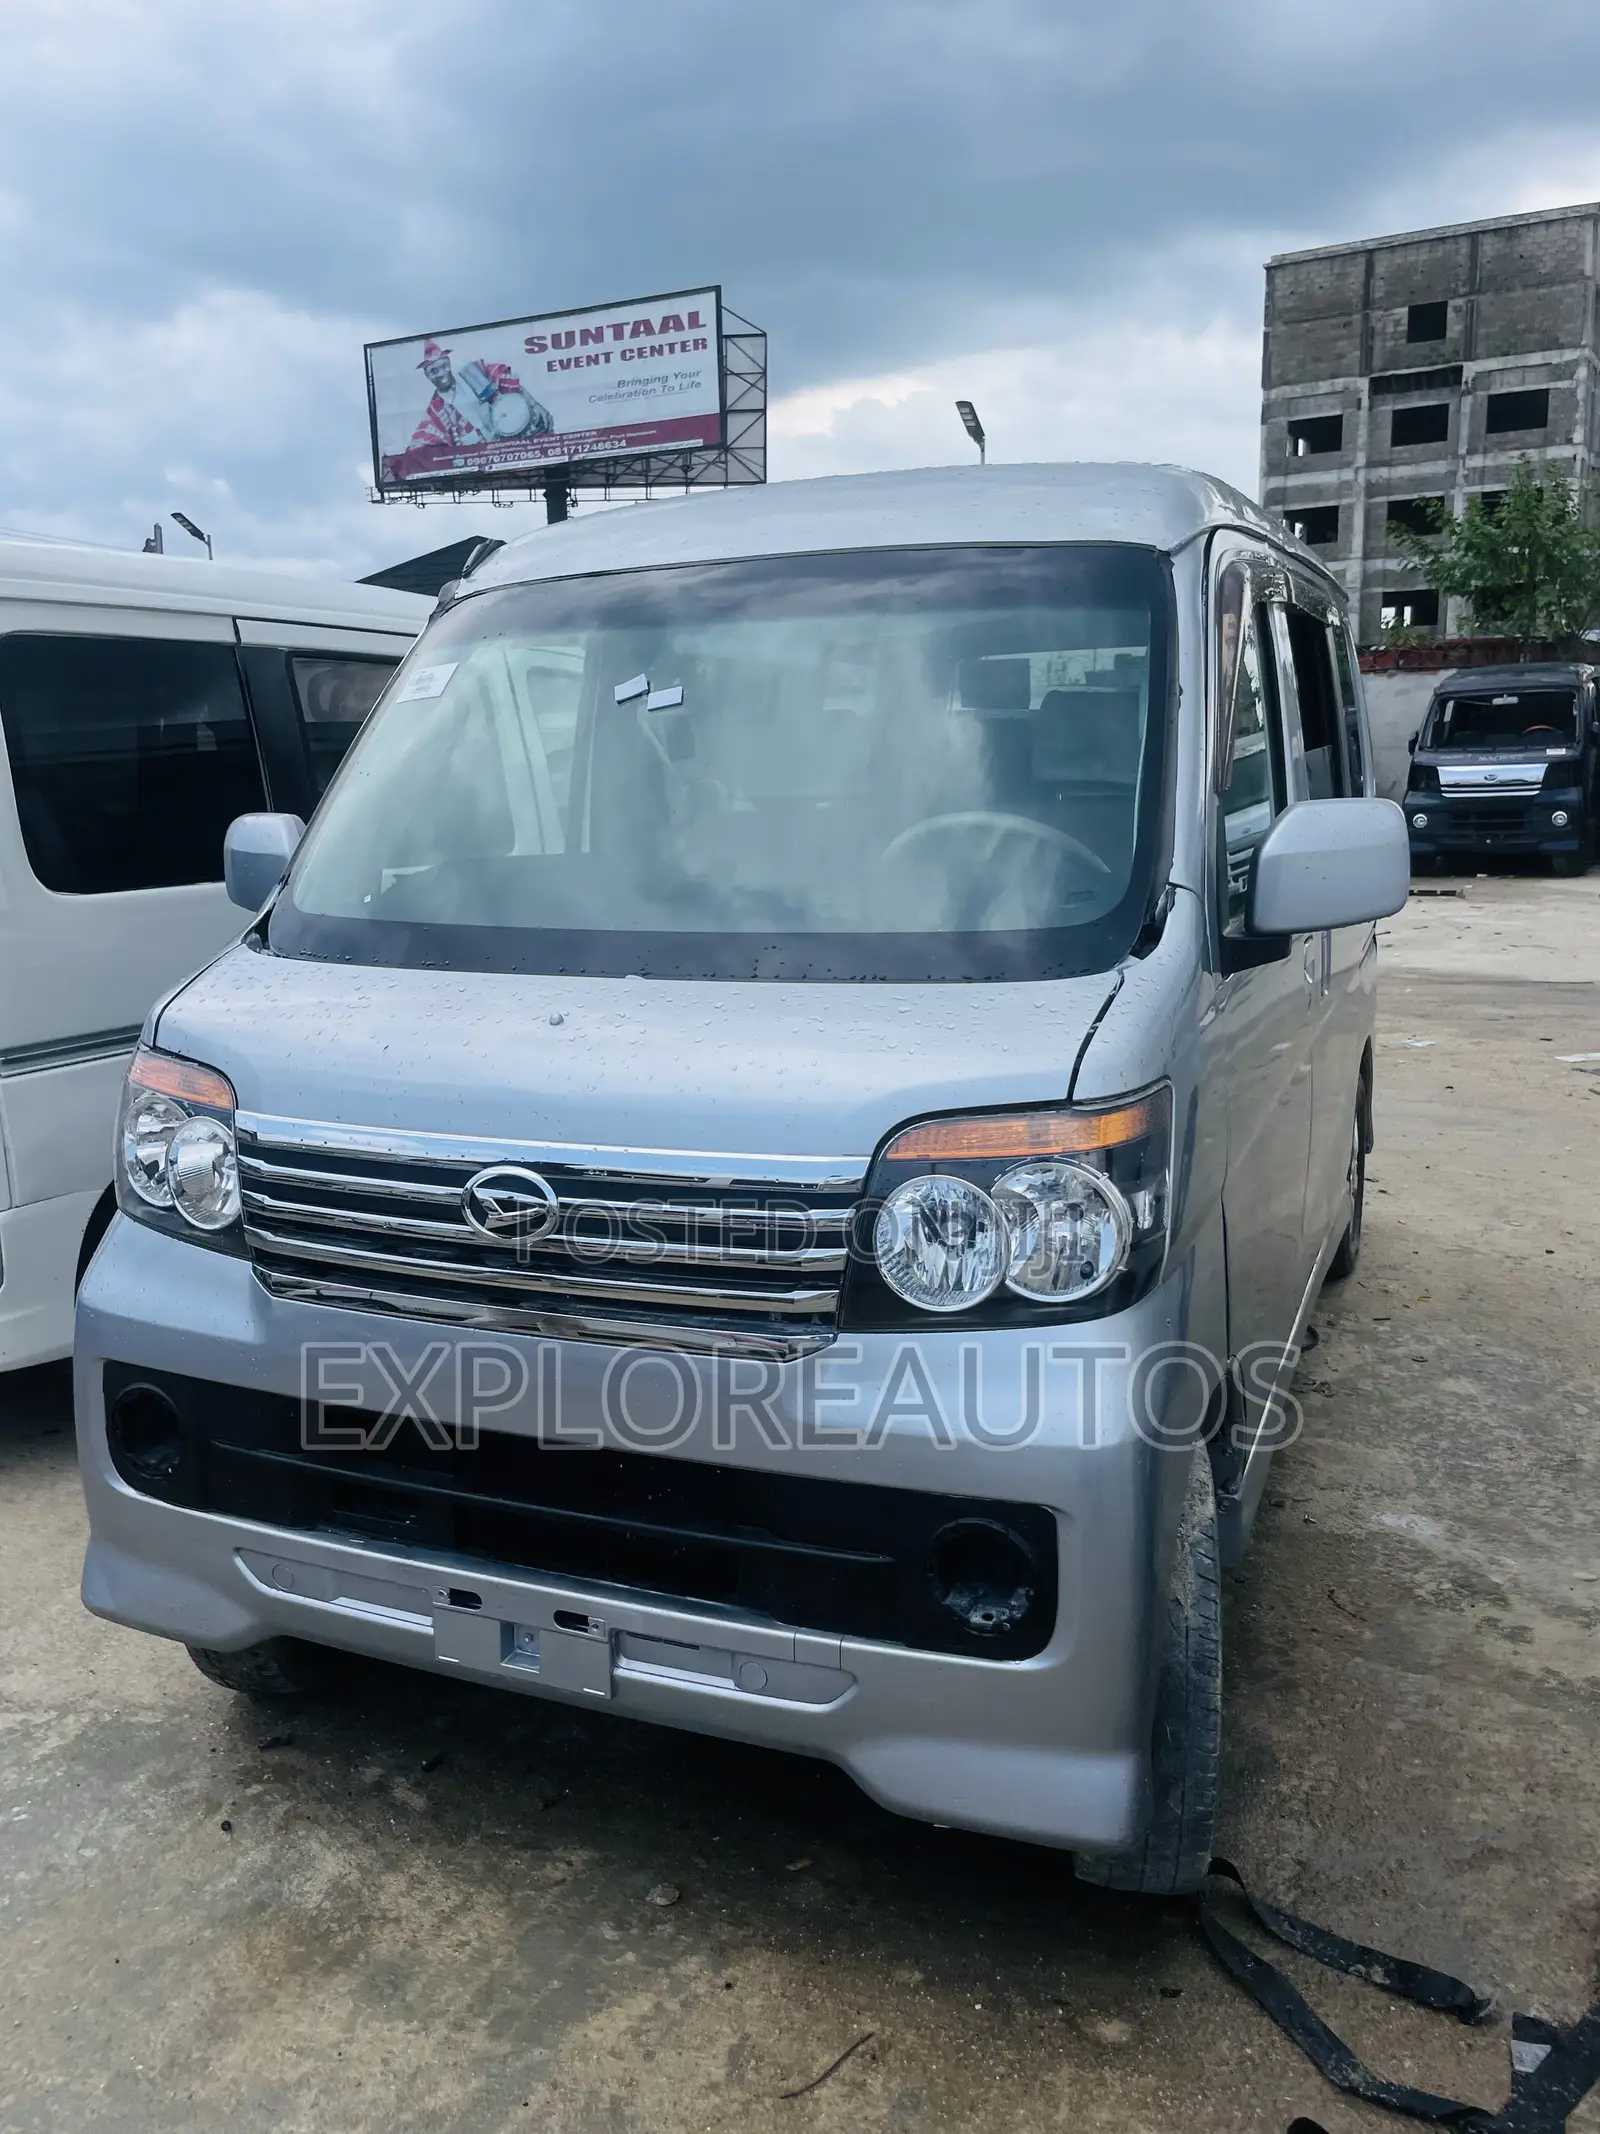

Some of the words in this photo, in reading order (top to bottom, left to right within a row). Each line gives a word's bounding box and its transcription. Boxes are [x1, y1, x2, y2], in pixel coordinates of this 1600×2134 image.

[524, 310, 707, 355] SUNTAAL
[547, 351, 614, 373] EVENT
[620, 337, 708, 361] CENTER
[588, 388, 656, 404] Celebration
[661, 384, 675, 393] To
[679, 381, 702, 392] Life
[617, 374, 669, 389] Bringing
[673, 370, 702, 381] Your
